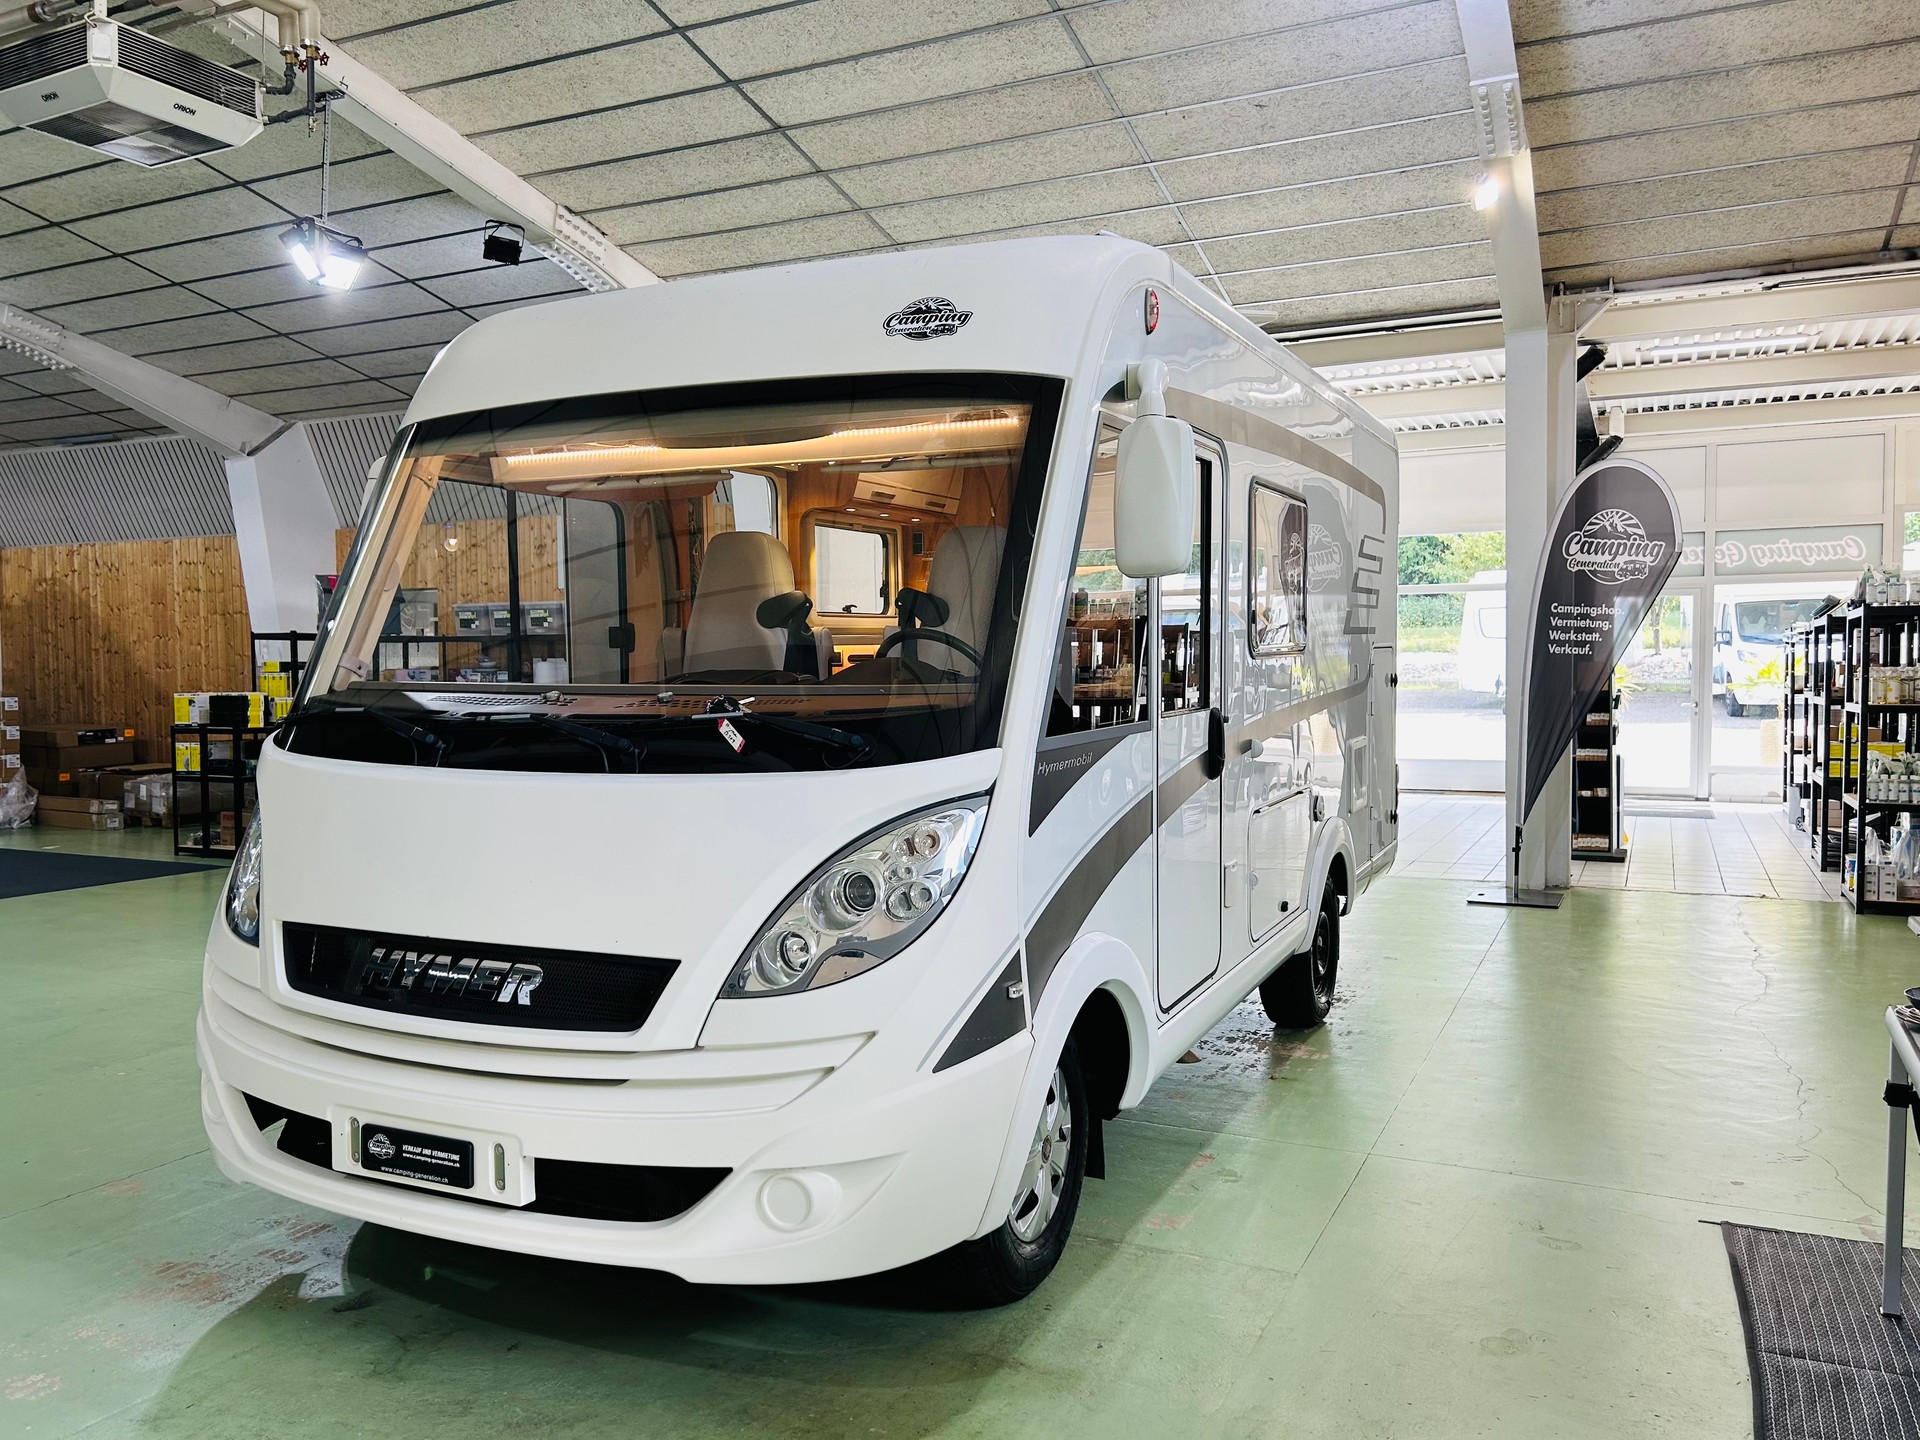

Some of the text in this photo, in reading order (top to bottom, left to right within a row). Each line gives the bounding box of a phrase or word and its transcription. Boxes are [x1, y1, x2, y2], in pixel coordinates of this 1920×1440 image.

[173, 103, 196, 116] ORION
[884, 310, 972, 327] Camping
[1563, 532, 1665, 565] Camping
[1568, 558, 1620, 571] Generation
[1551, 603, 1625, 616] Campingshop.
[1550, 616, 1612, 630] Vermietung.
[1549, 630, 1602, 642] Werkstatt.
[1548, 643, 1593, 655] Verkauf.
[1037, 752, 1093, 776] Hymermobil
[361, 947, 544, 1006] HYMER
[402, 1144, 460, 1161] VERKAUF UND VERMIETUNG
[402, 1152, 460, 1168] www.camping-generation.ch
[381, 1166, 449, 1184] www.camping-generation.ch
